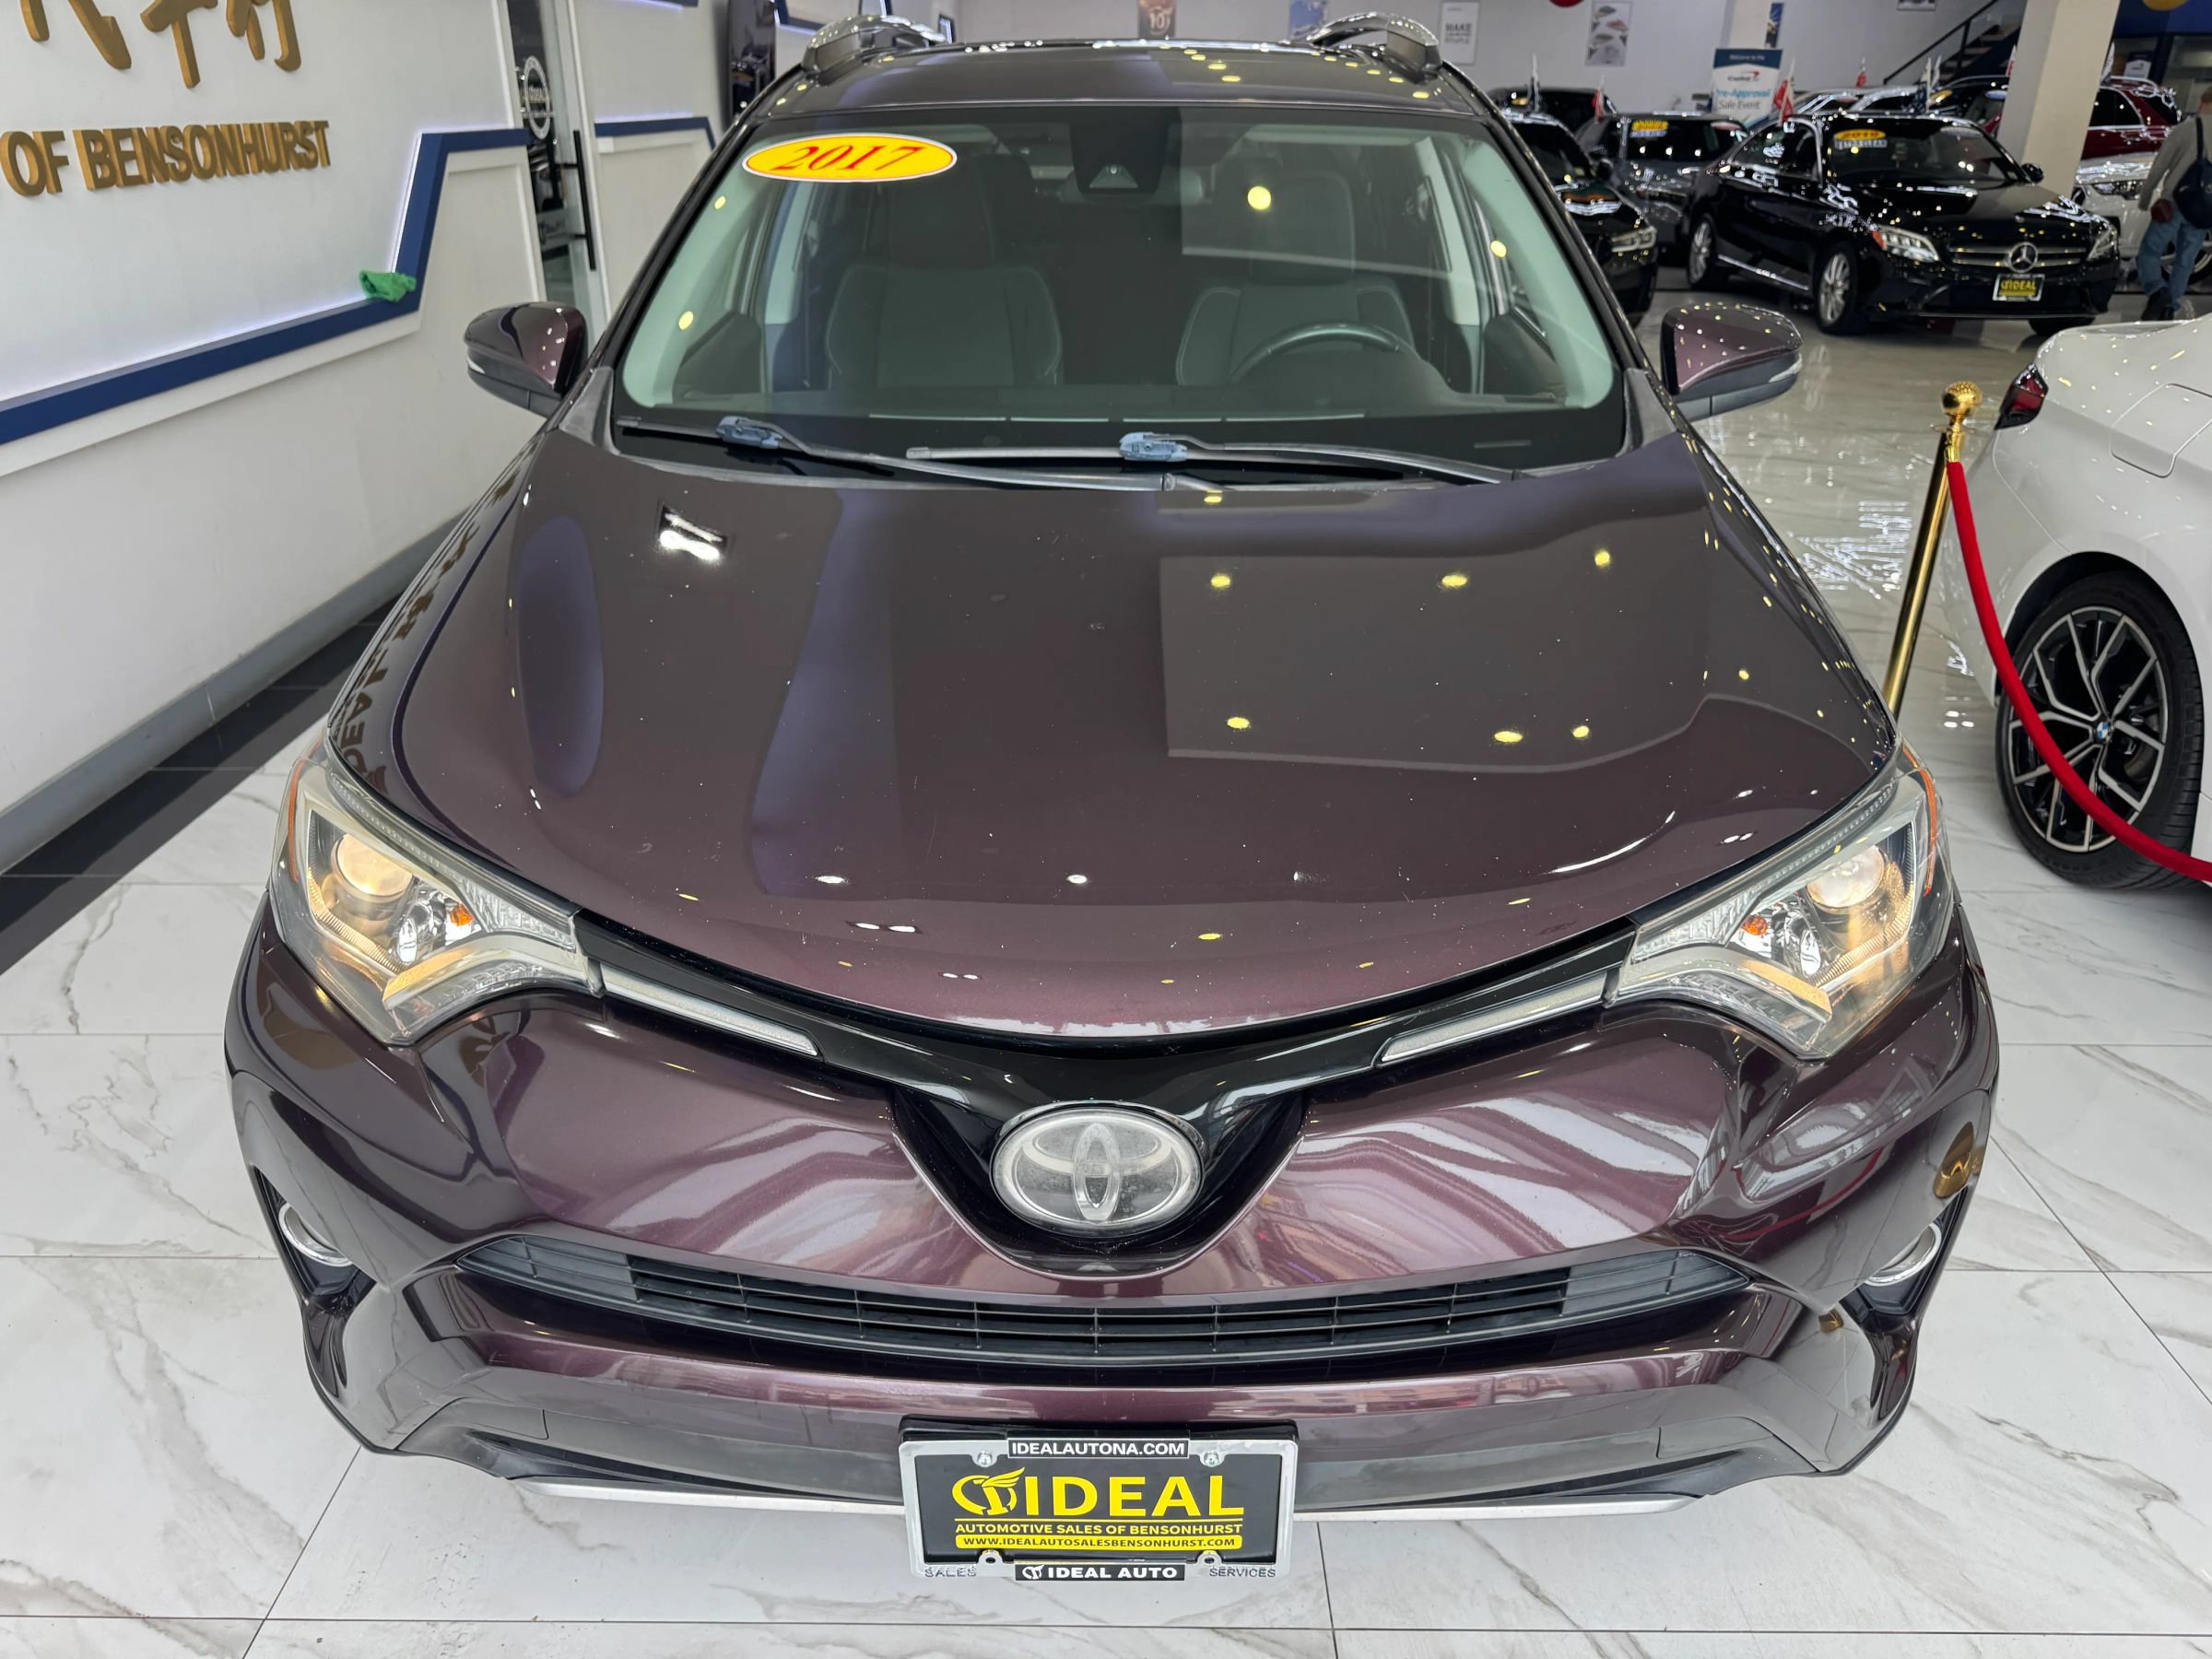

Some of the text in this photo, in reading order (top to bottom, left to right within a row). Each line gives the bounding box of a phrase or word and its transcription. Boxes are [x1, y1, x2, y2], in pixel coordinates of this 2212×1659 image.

[0, 120, 331, 196] OF BENSONHURST
[770, 145, 927, 171] 2017
[1011, 1442, 1185, 1455] IDEALAUTONA.COM
[1024, 1475, 1244, 1516] IDEAL
[955, 1524, 1242, 1535] AUTOMOTIVE SALES OF BENSONHURST
[963, 1537, 1235, 1547] WWW.IDEALAUTOSALESBENSONHURST.COM
[924, 1567, 977, 1578] SALES
[1048, 1567, 1178, 1579] IDEAL AUTO
[1209, 1567, 1277, 1579] SERVICES
